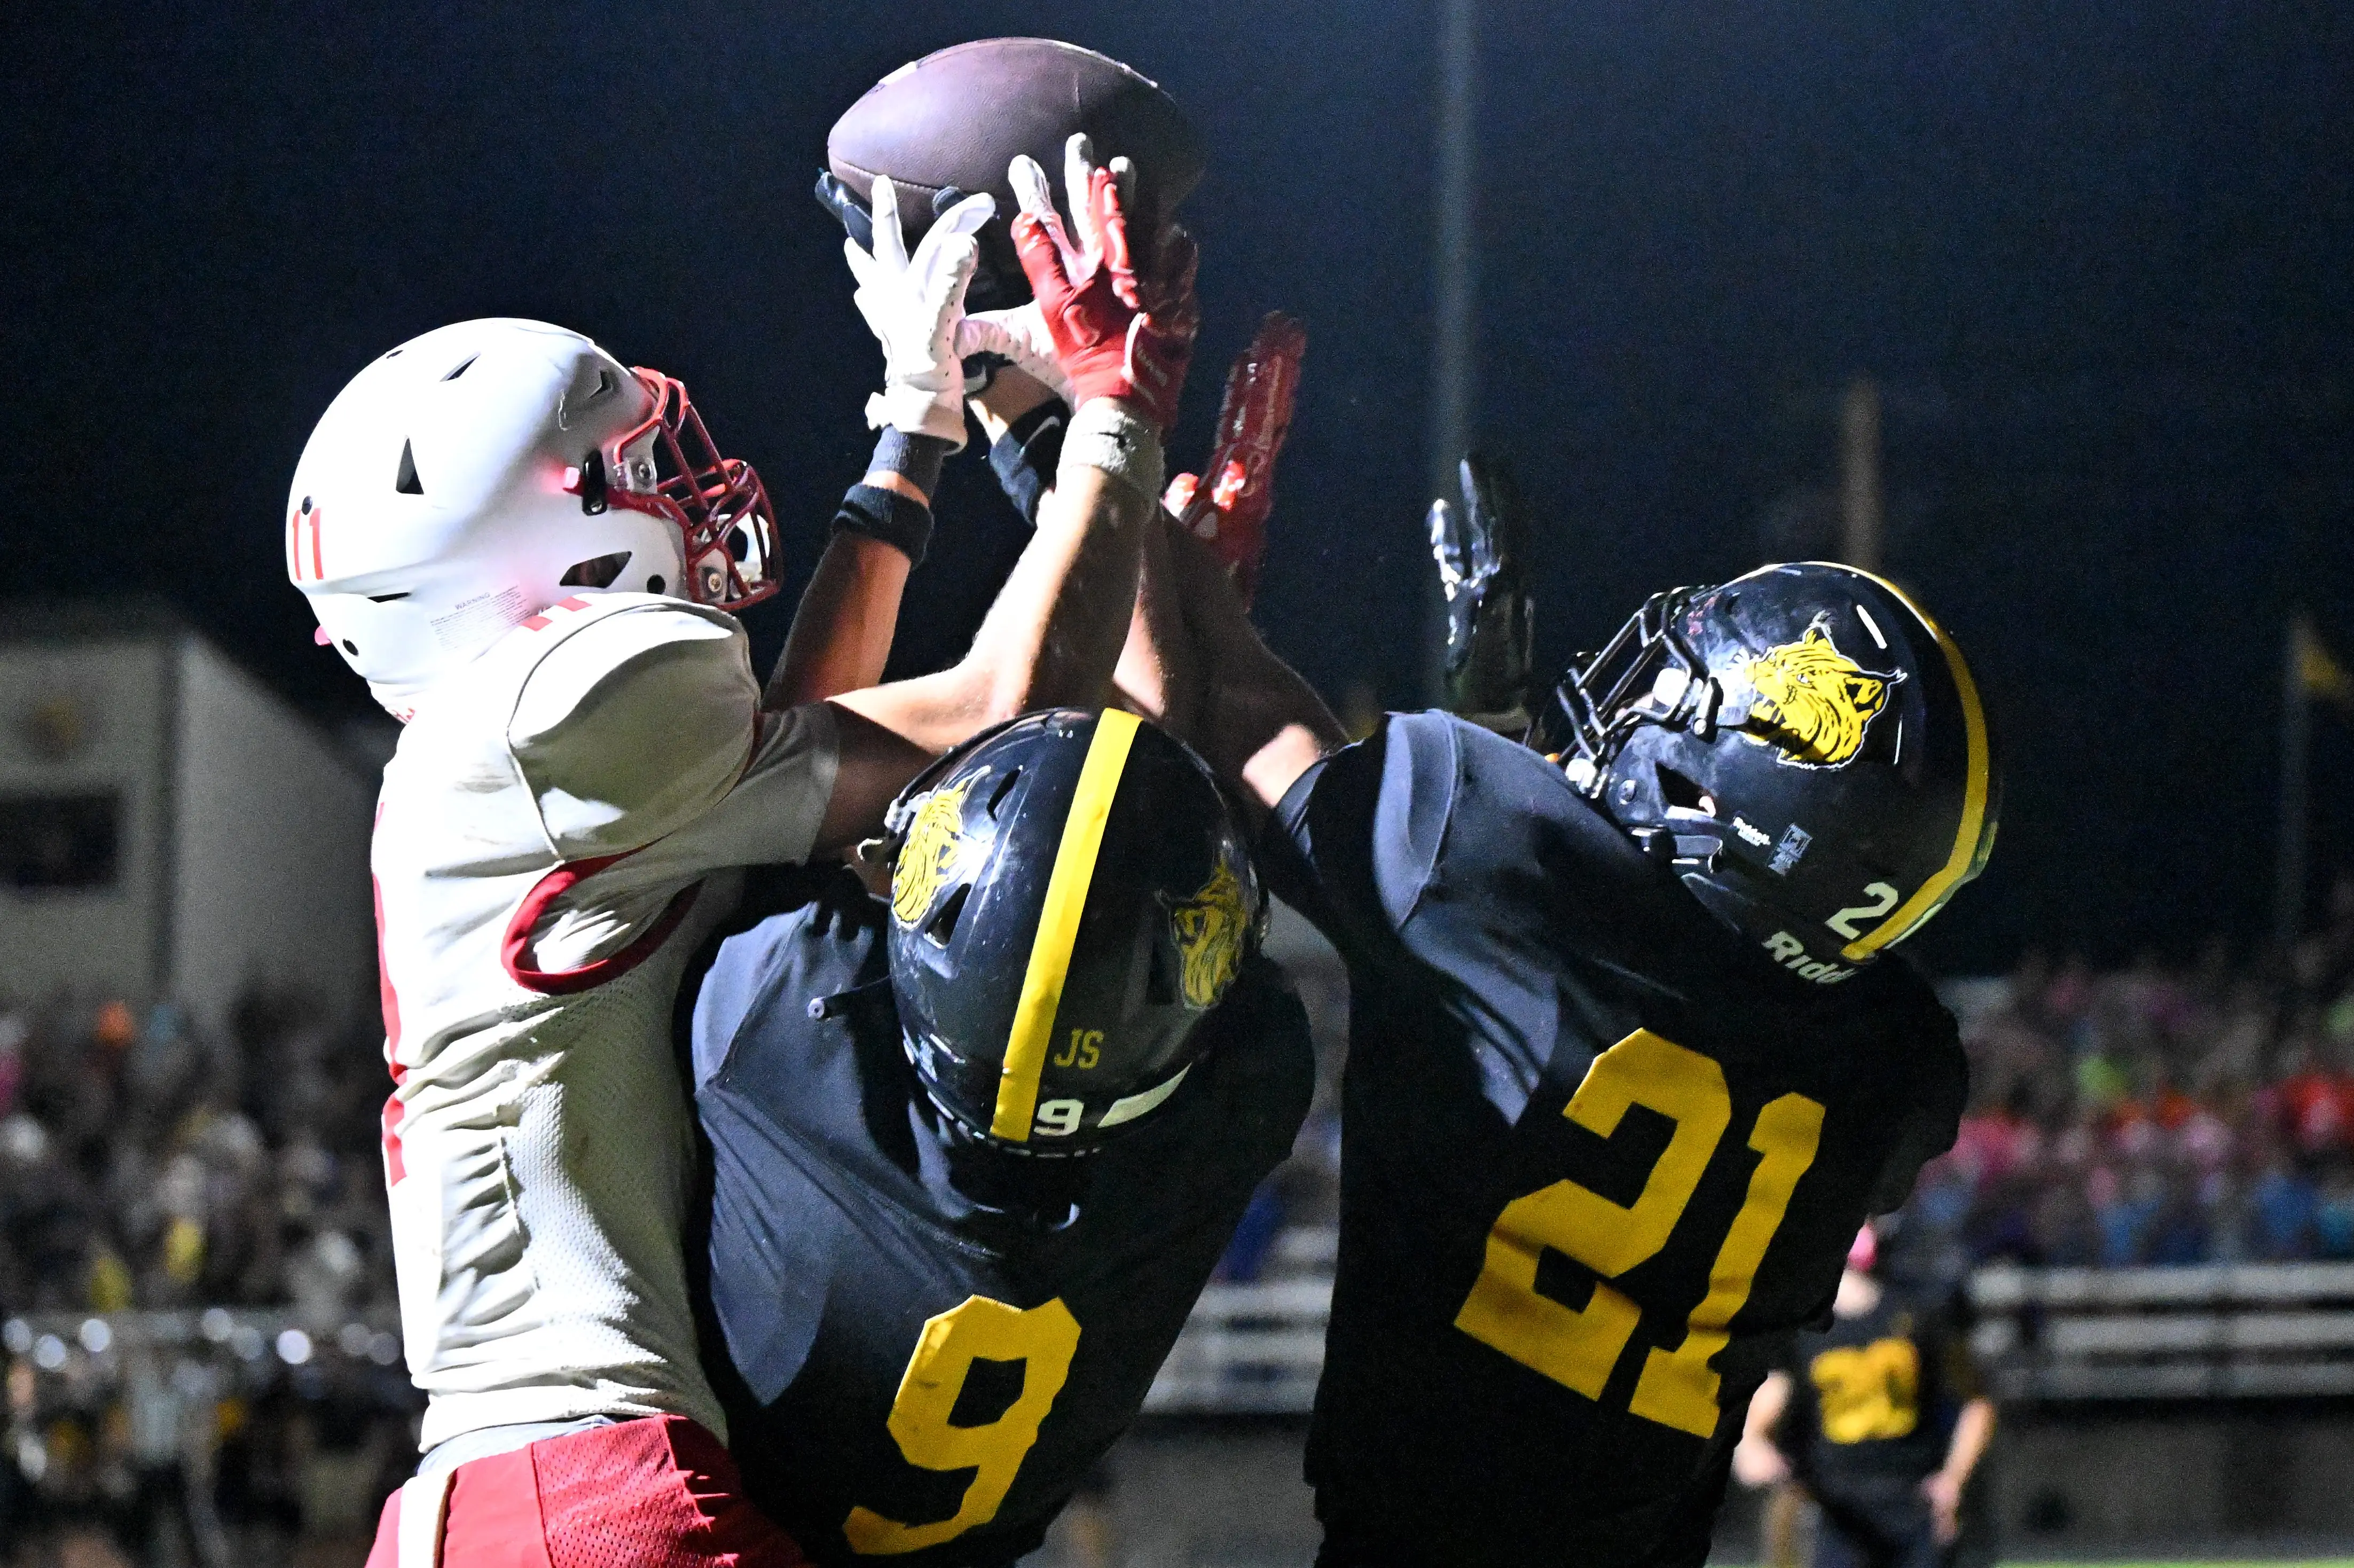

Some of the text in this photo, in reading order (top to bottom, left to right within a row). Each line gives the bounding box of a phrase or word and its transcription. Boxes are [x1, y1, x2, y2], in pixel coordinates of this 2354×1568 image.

[293, 507, 324, 581] 11
[454, 592, 491, 610] WARNING
[1825, 882, 1899, 940] 2
[1054, 1029, 1104, 1069] JS
[1034, 1099, 1085, 1136] 9
[1455, 1027, 1826, 1439] 21
[843, 1295, 1082, 1555] 9
